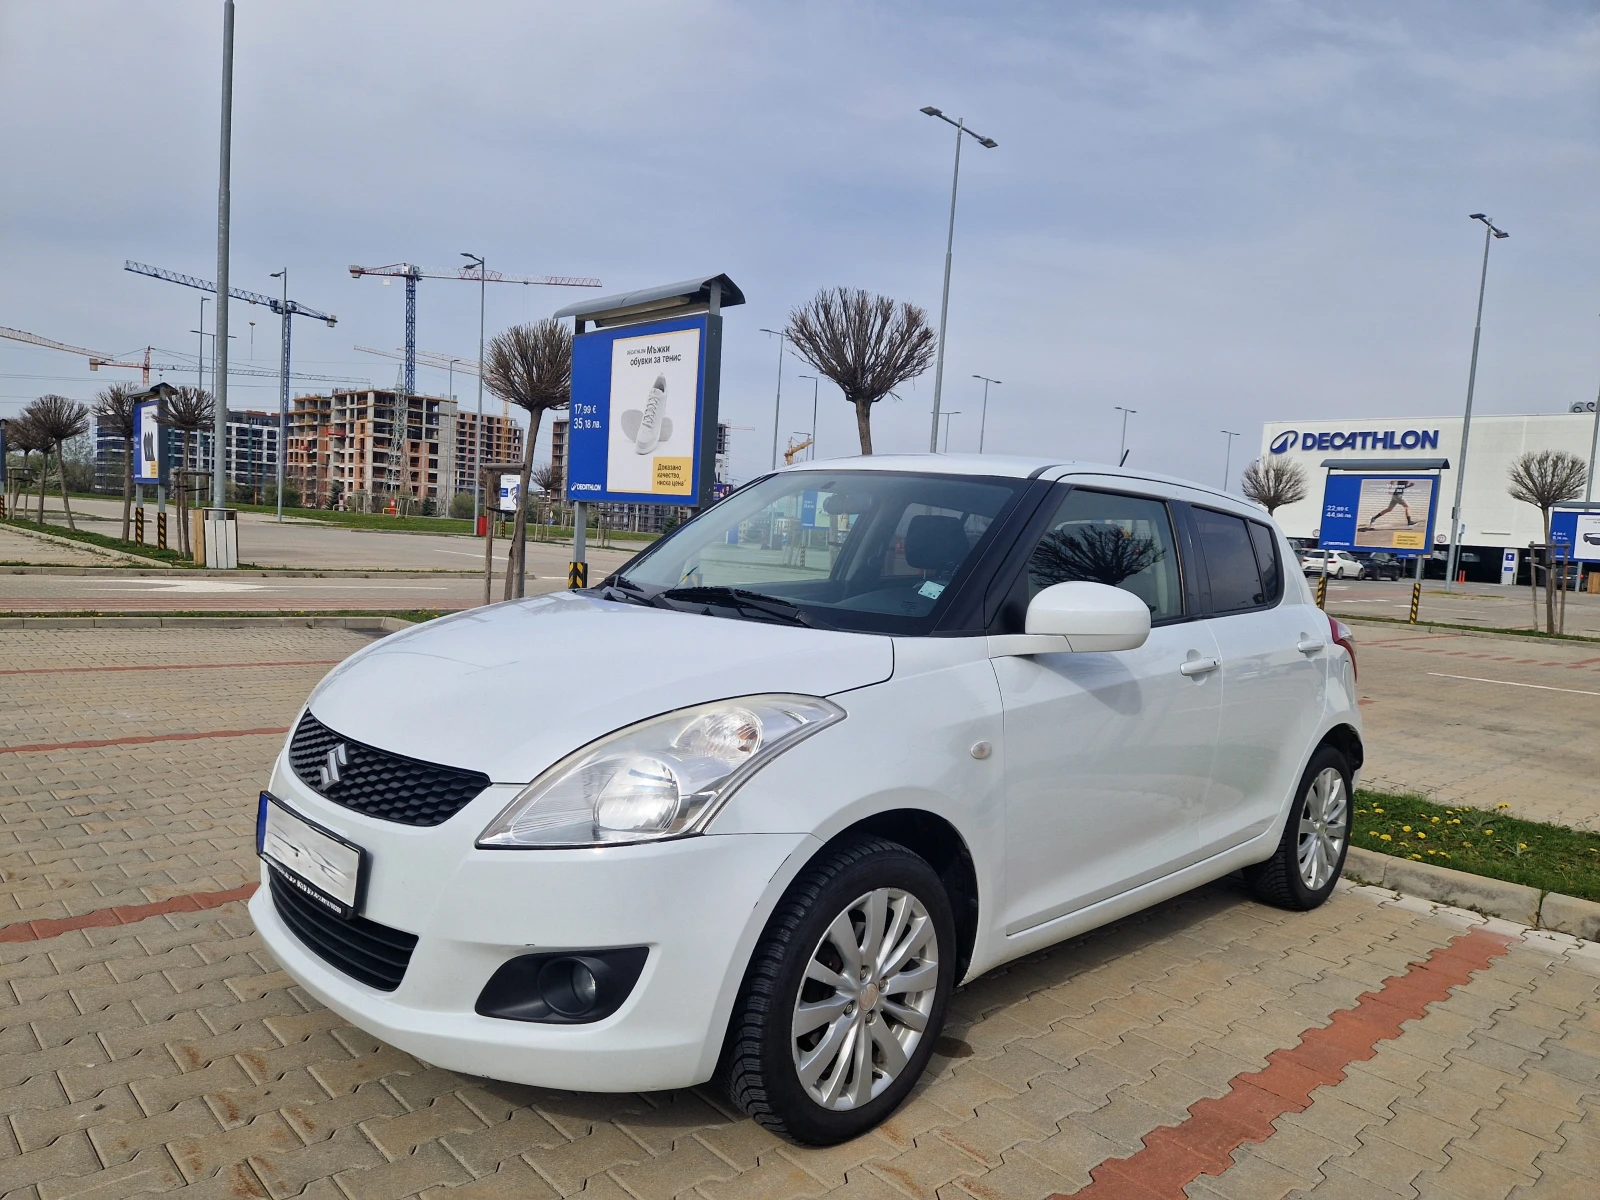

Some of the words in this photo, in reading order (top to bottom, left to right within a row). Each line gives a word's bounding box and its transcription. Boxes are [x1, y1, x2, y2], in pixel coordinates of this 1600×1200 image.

[647, 345, 670, 354] Мъжки
[630, 357, 652, 367] обувки
[654, 356, 660, 364] за
[662, 354, 681, 363] тенис
[574, 404, 591, 415] 17,99
[592, 405, 597, 413] €
[573, 418, 591, 430] 35,18
[592, 420, 602, 429] лв.
[1301, 430, 1439, 450] DECATHLON
[657, 463, 681, 471] Доказано
[576, 483, 602, 491] DECATHLON
